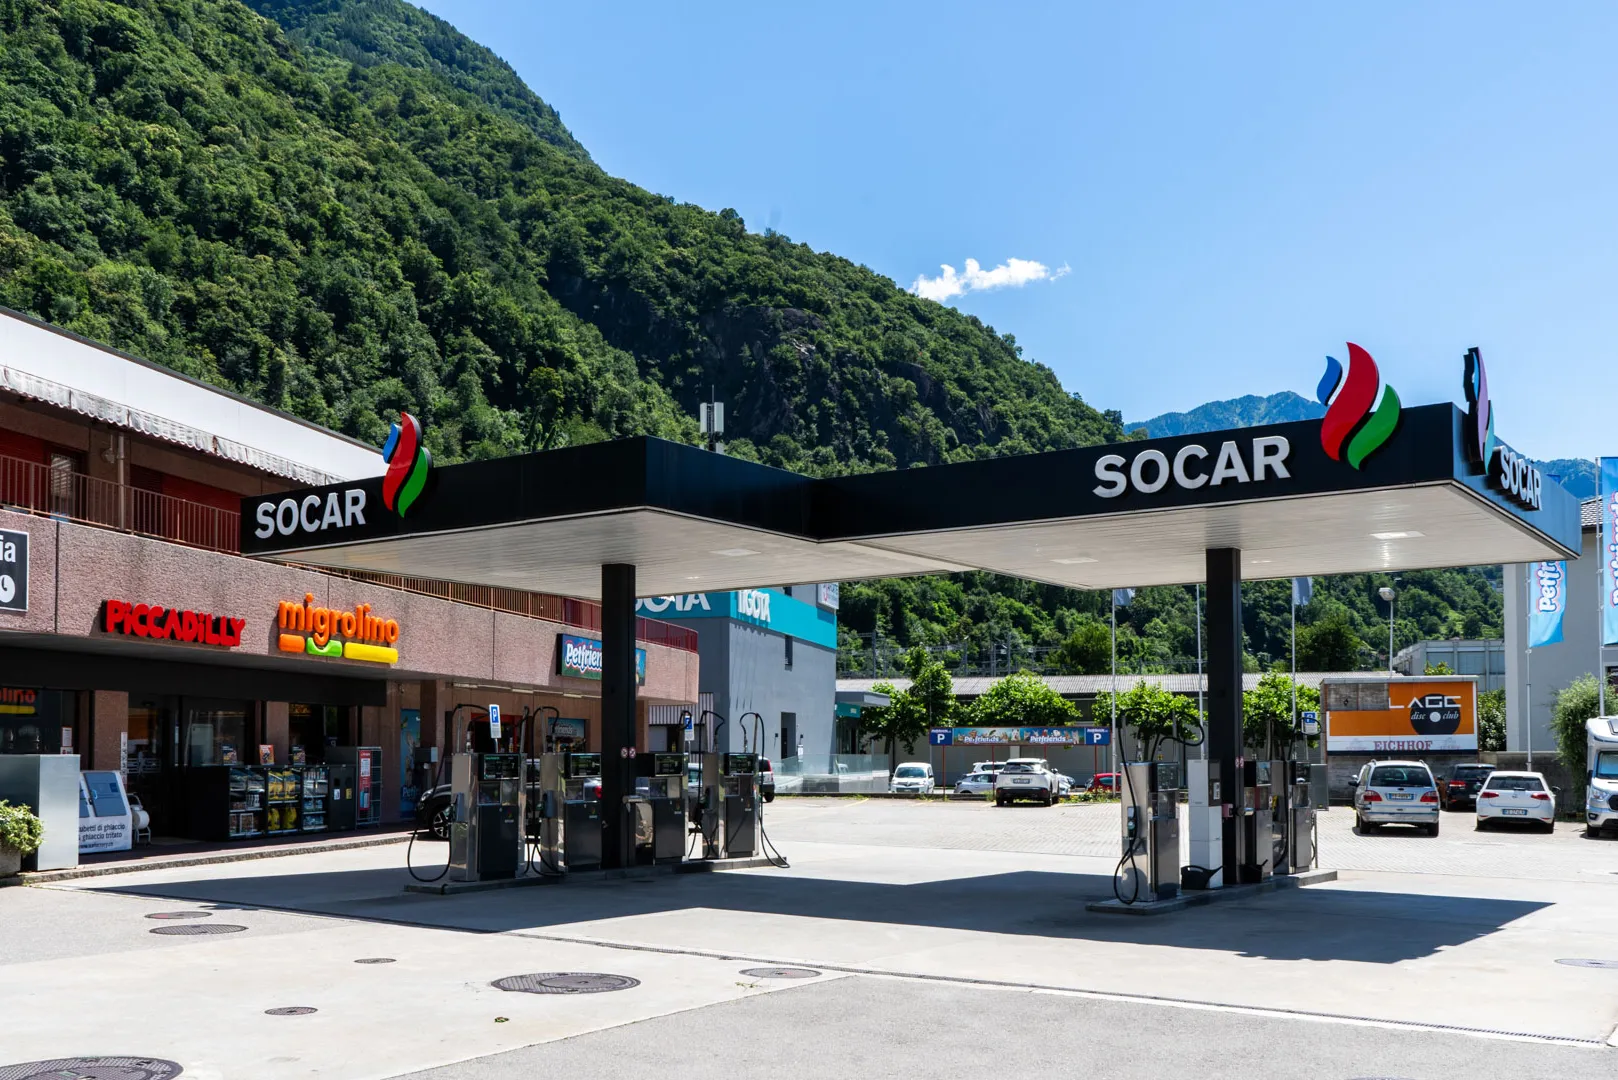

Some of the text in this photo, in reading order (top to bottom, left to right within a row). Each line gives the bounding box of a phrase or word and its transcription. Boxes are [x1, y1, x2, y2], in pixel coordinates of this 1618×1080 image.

[1092, 435, 1291, 498] SOCAR
[1500, 445, 1542, 511] SOCAR
[254, 488, 367, 539] SOCAR
[278, 592, 399, 646] migrolino
[1442, 710, 1459, 720] club
[937, 733, 946, 744] P
[1093, 732, 1102, 744] P
[1373, 740, 1433, 751] EICHHOF
